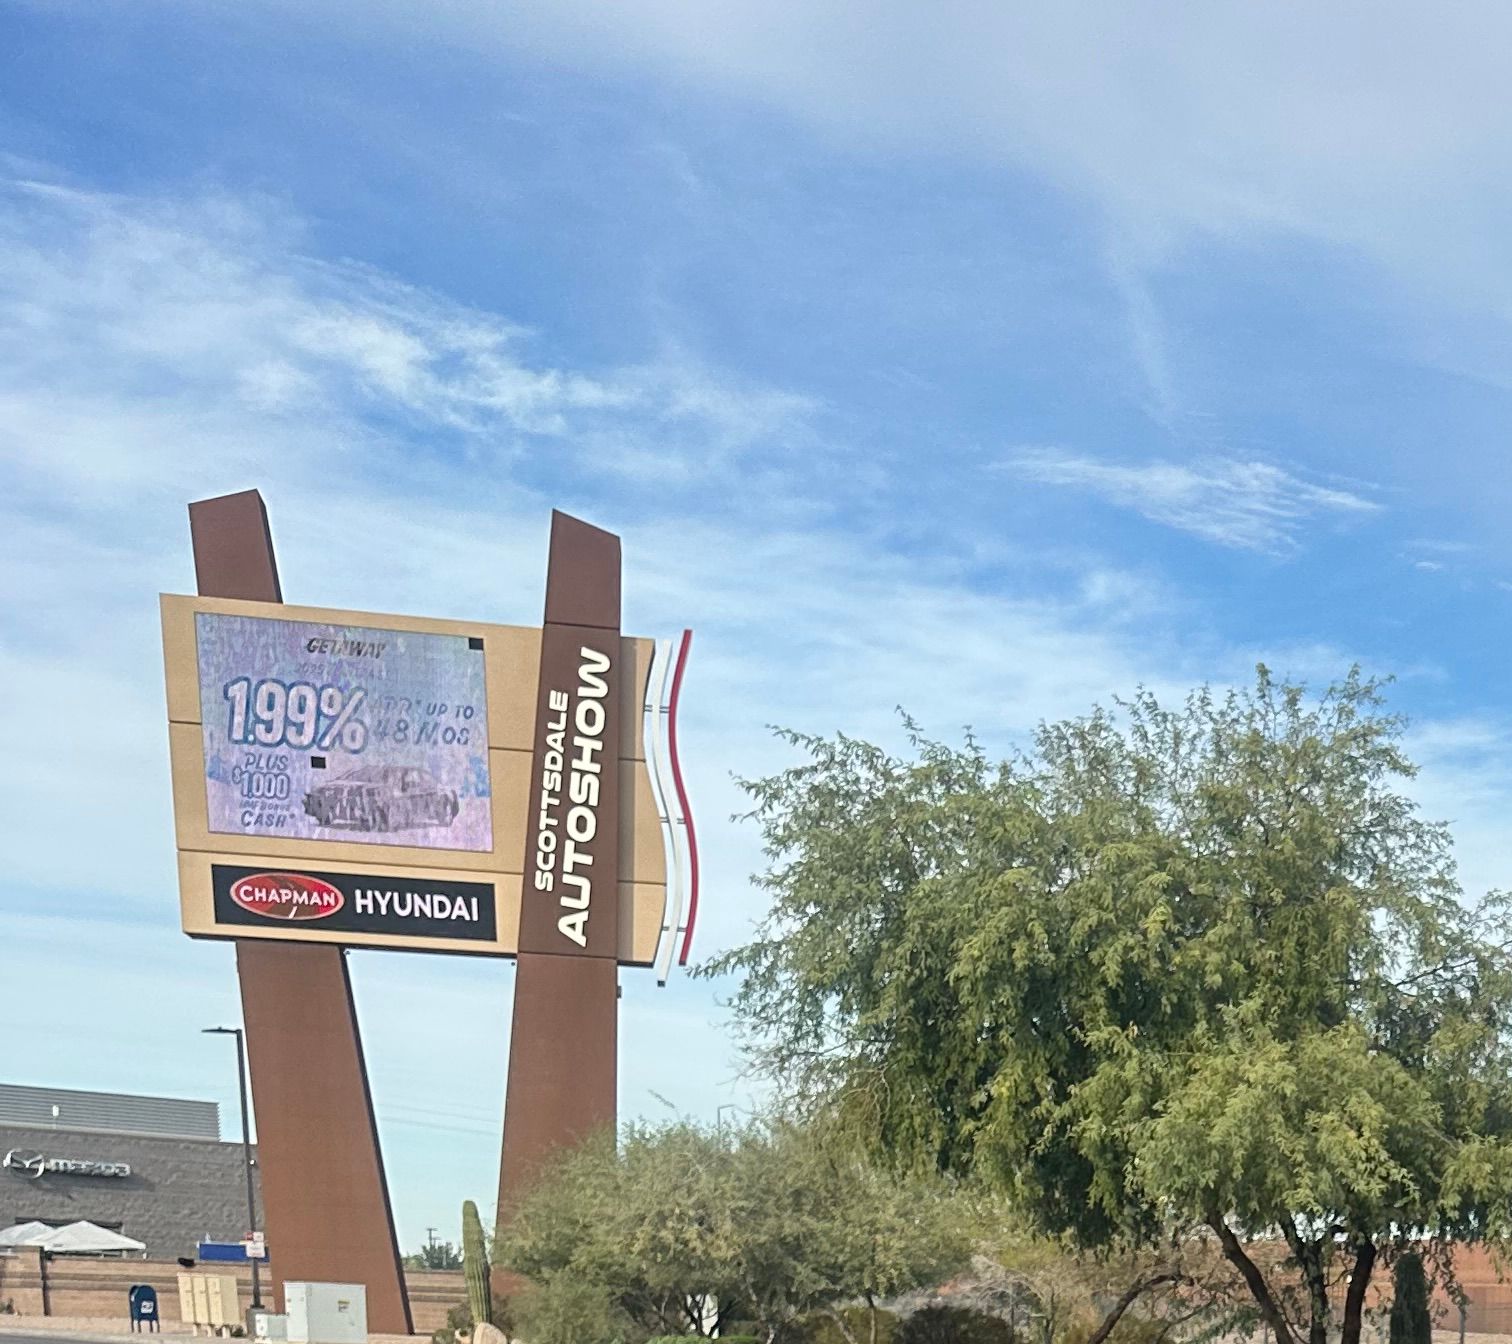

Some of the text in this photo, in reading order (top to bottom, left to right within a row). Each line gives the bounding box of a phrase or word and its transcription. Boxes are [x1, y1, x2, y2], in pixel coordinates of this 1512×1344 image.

[426, 703, 448, 717] UP
[455, 704, 474, 720] TO
[245, 752, 289, 771] PLUS
[534, 690, 569, 892] SCOTTSDALE
[557, 646, 611, 948] AUTOSHOW
[239, 885, 479, 922] CHAPMAN HYUNDAI
